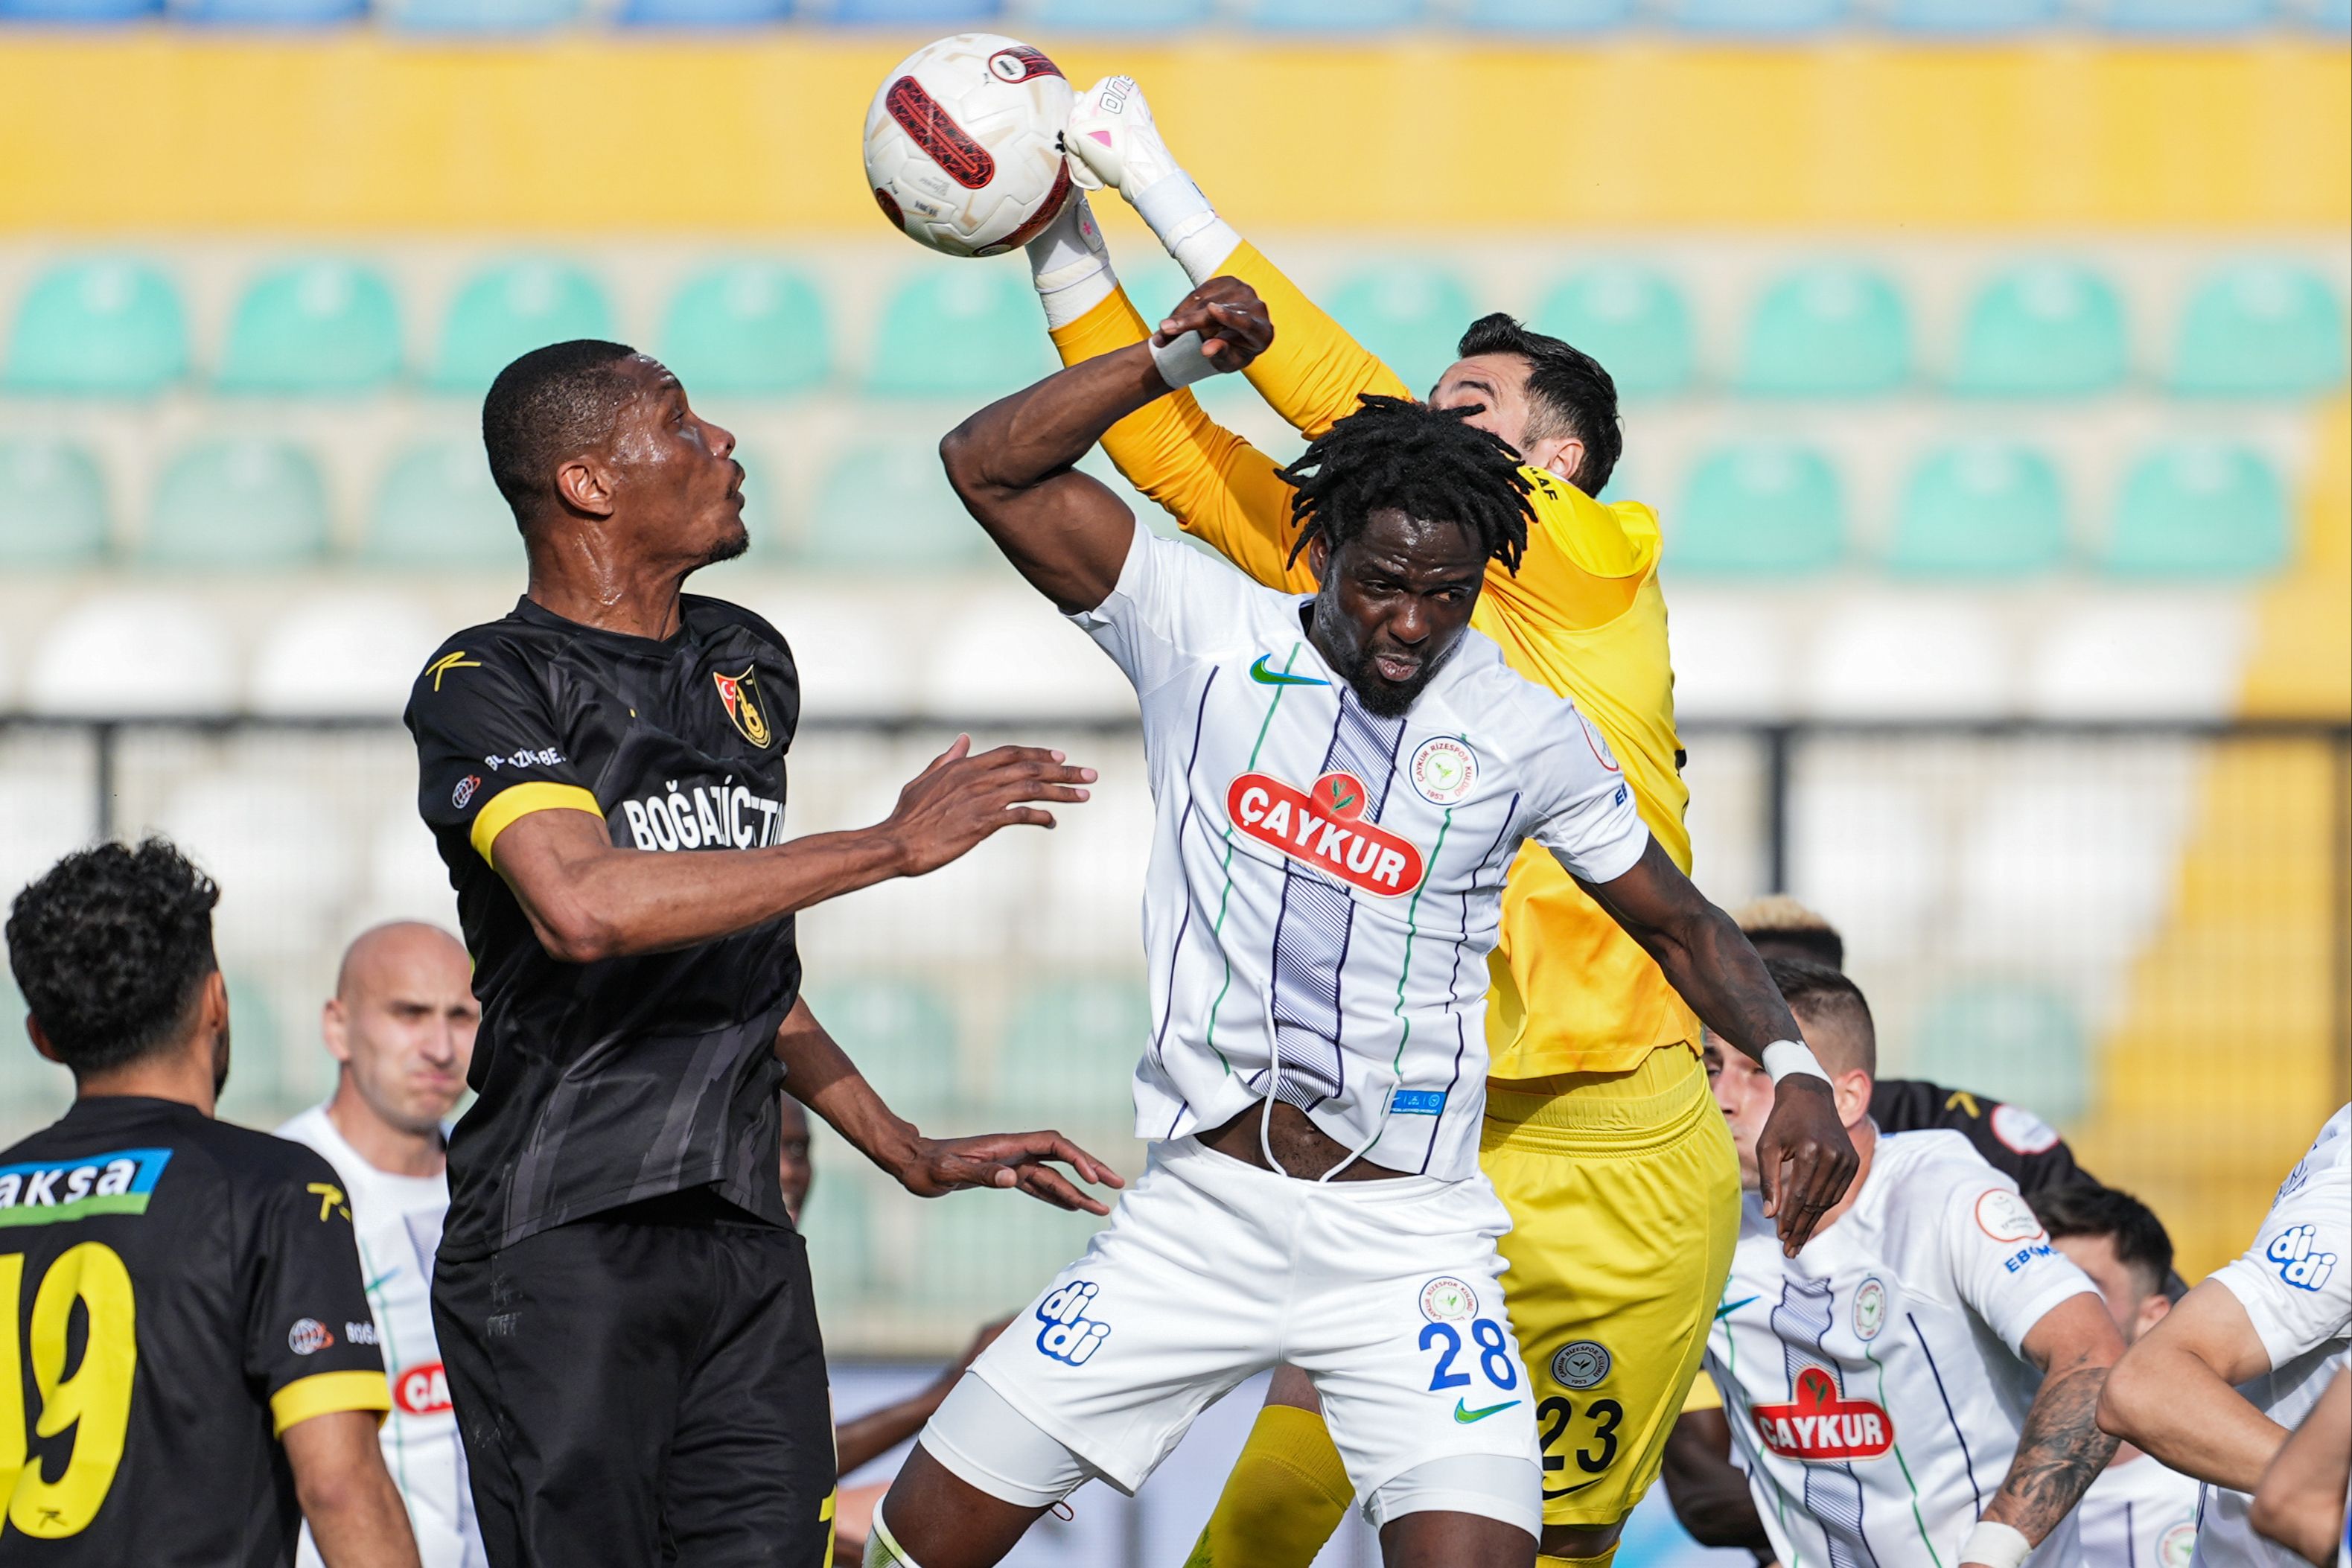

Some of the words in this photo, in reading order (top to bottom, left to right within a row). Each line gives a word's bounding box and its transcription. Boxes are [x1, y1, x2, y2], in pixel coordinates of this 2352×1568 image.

[1240, 786, 1406, 888] ÇAYKUR
[1418, 1319, 1517, 1391] 28
[1536, 1396, 1623, 1473] 23
[1759, 1413, 1885, 1450] ÇAYKUR
